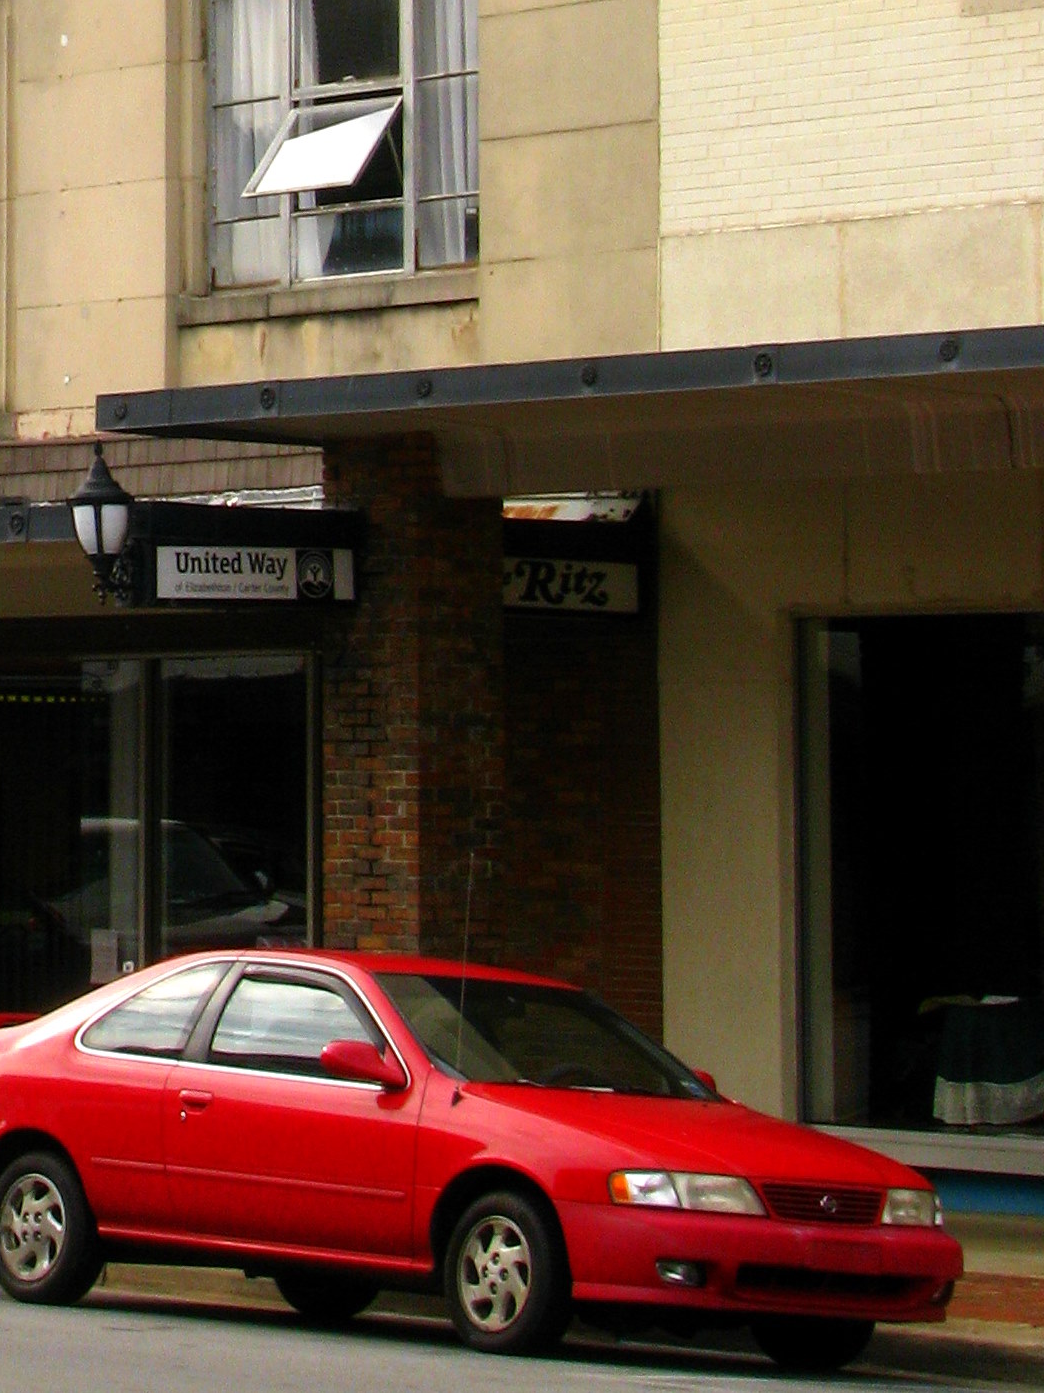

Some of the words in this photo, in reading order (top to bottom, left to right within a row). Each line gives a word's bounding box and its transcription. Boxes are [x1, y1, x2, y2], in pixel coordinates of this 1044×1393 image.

[175, 551, 243, 574] United
[246, 552, 288, 581] Way
[515, 560, 609, 606] Ritz
